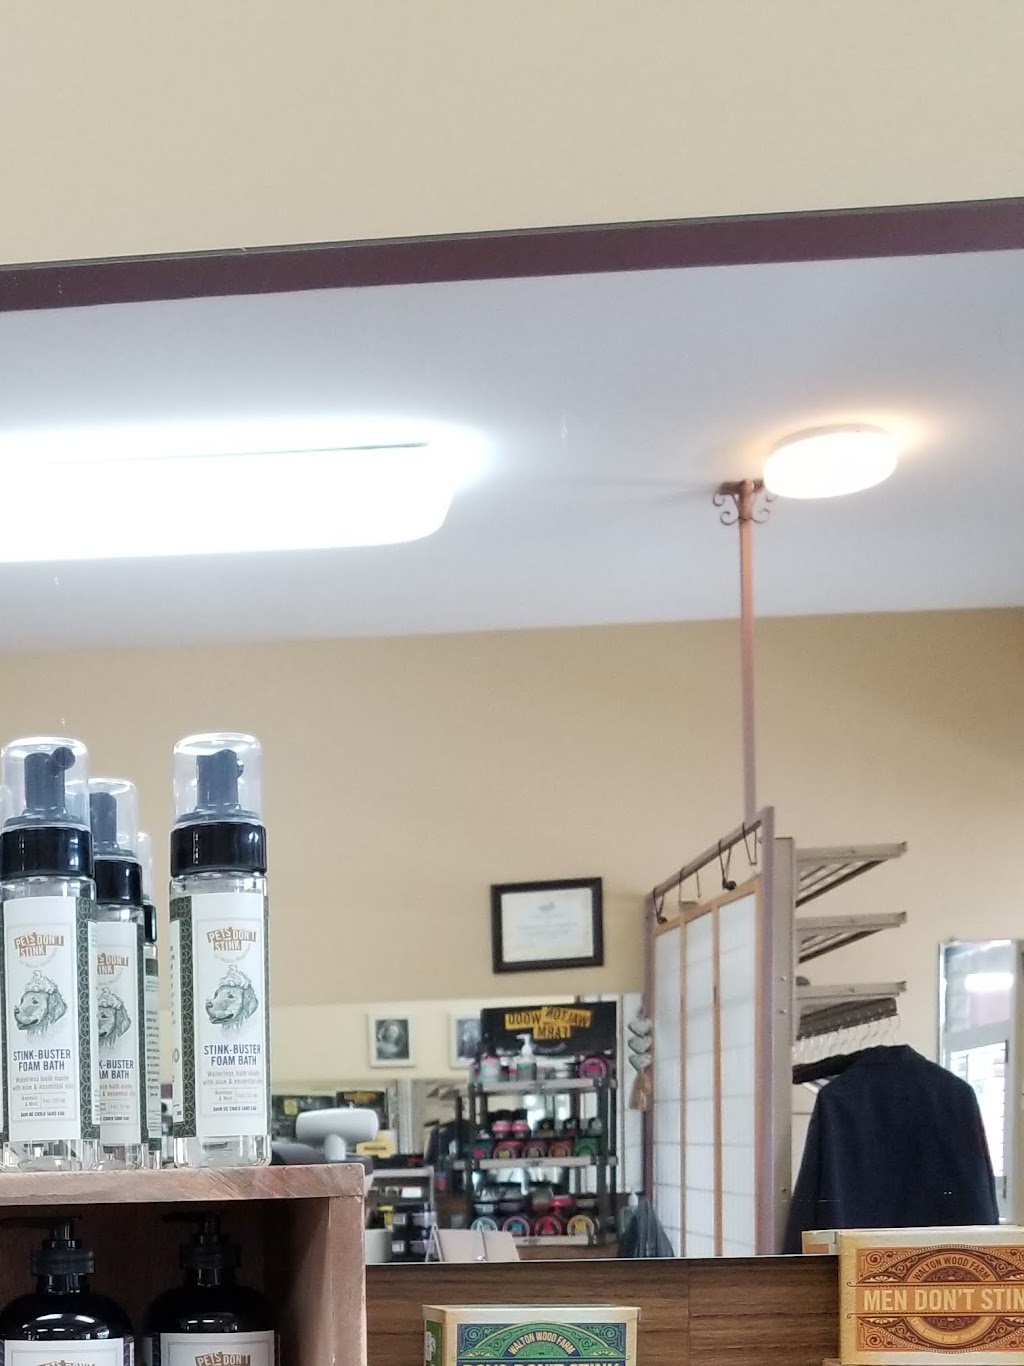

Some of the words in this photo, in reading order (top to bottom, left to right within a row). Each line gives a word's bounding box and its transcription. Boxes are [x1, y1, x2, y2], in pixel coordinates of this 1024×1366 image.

[13, 1049, 71, 1061] STINK-BUSTER
[203, 1044, 261, 1055] STINK-BUSTER
[18, 1061, 41, 1071] FOAM
[43, 1060, 65, 1071] BATH
[211, 1056, 236, 1066] FOAM
[238, 1055, 257, 1066] BATH
[112, 1070, 129, 1079] BATH
[913, 1258, 942, 1280] WALTON
[944, 1256, 969, 1267] WOOD
[969, 1260, 990, 1280] FARM
[863, 1289, 907, 1311] MEN
[914, 1288, 975, 1311] DON'T
[508, 1332, 535, 1355] WALTON
[535, 1331, 557, 1342] WOOD
[556, 1335, 576, 1355] FARM
[222, 1353, 251, 1366] DON'T
